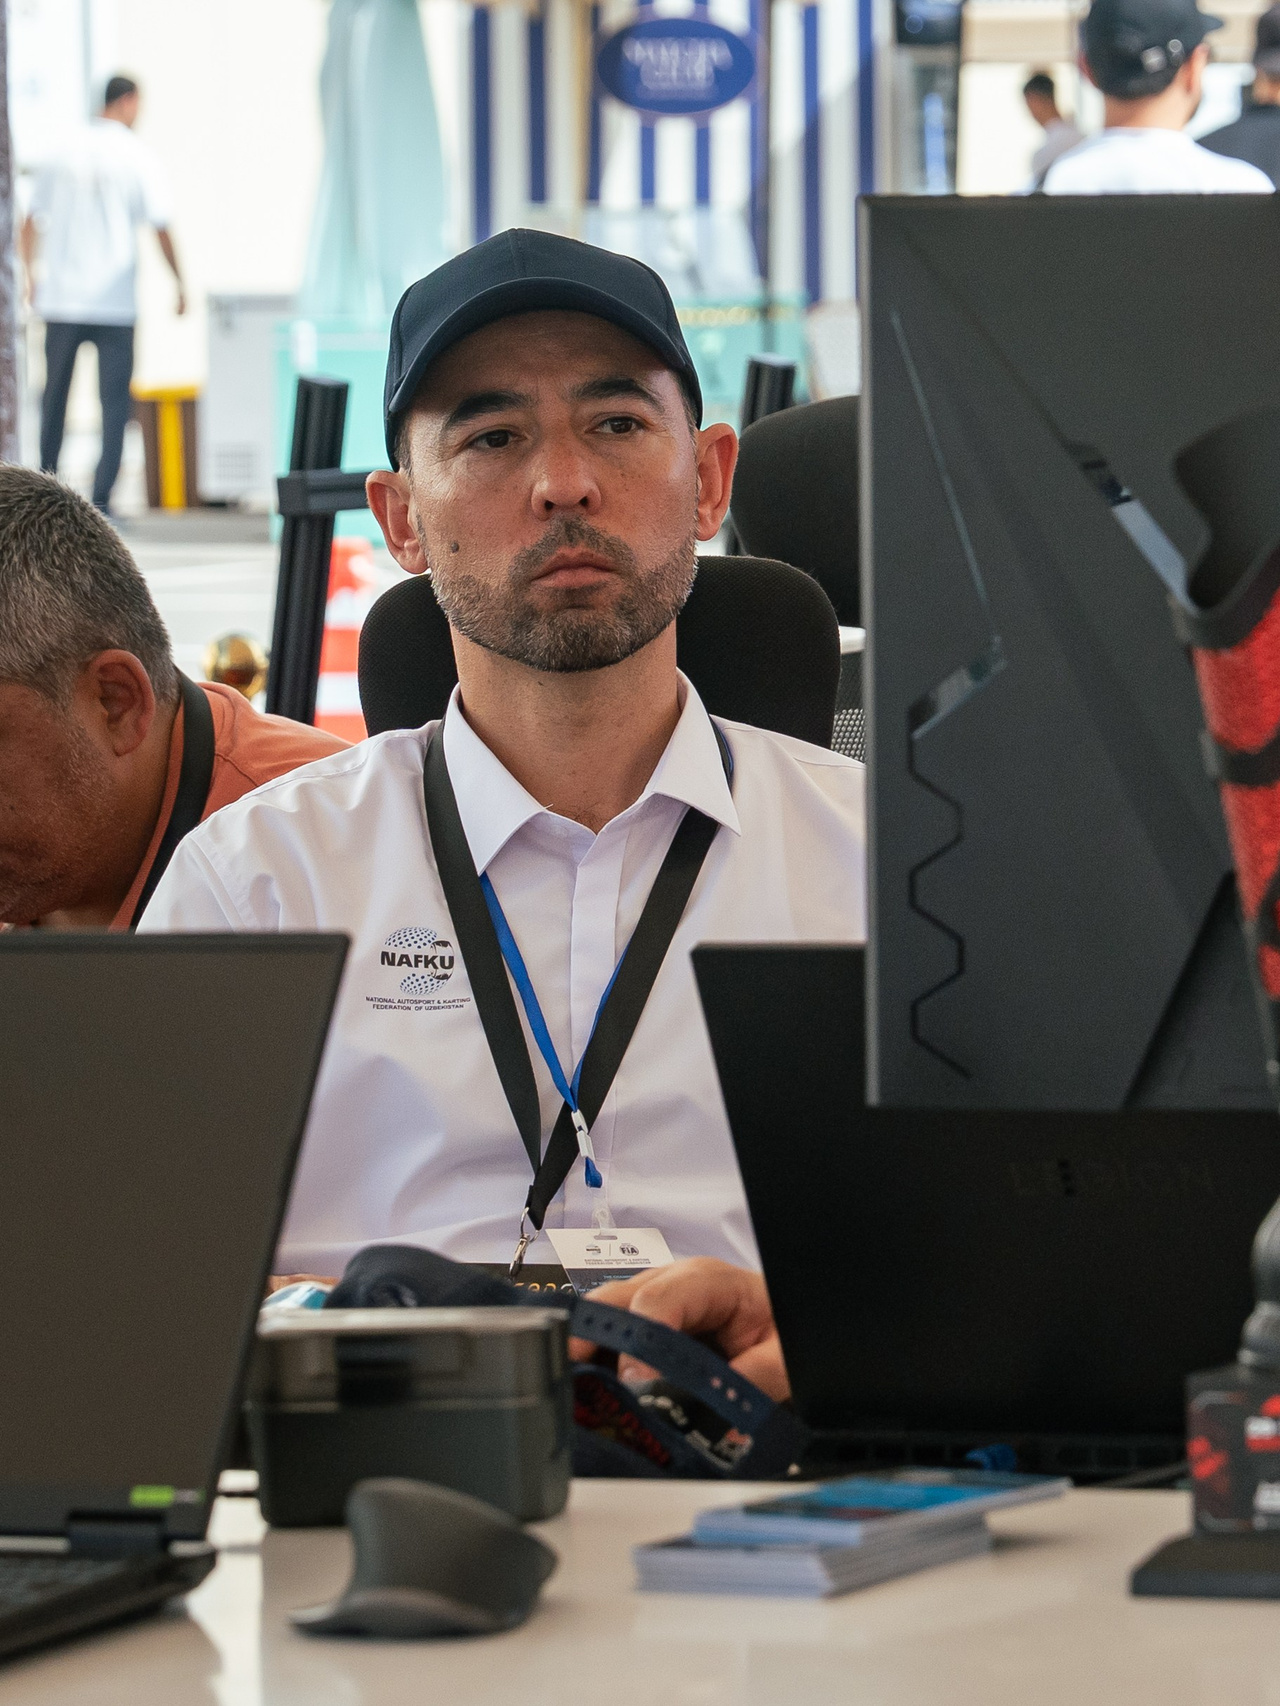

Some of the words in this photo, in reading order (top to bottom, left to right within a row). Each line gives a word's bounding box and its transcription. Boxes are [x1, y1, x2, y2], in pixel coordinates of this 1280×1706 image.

[380, 951, 455, 970] NAFKU
[365, 996, 395, 1004] NATIONAL
[372, 1003, 411, 1011] FEDERATION
[620, 1246, 638, 1255] FIA
